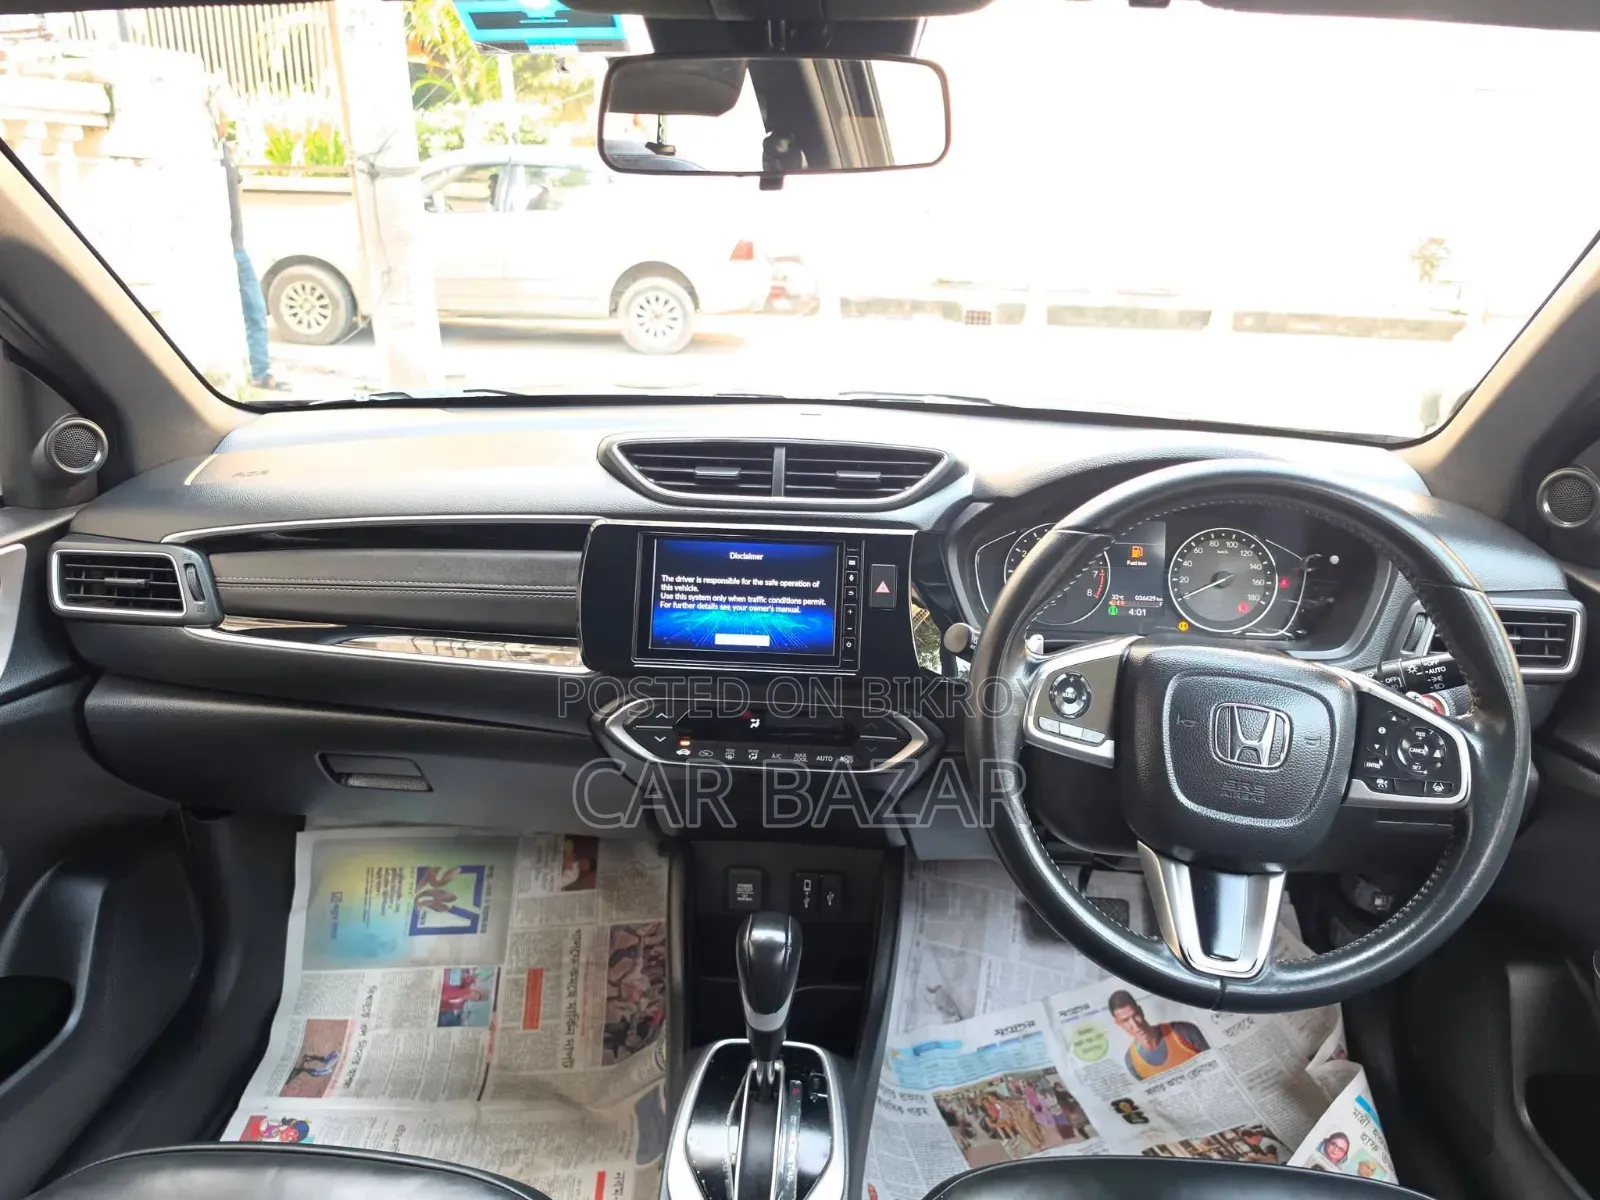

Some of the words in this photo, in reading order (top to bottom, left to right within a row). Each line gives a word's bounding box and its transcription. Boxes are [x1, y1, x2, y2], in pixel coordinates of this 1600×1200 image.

[730, 551, 764, 560] Disclaimer
[703, 577, 740, 586] responsible
[780, 580, 811, 588] operation
[1086, 589, 1093, 597] 8
[688, 594, 711, 602] system
[712, 594, 727, 603] only
[803, 598, 826, 606] permit.
[1128, 608, 1146, 616] 4:01
[1428, 666, 1446, 674] AUTO
